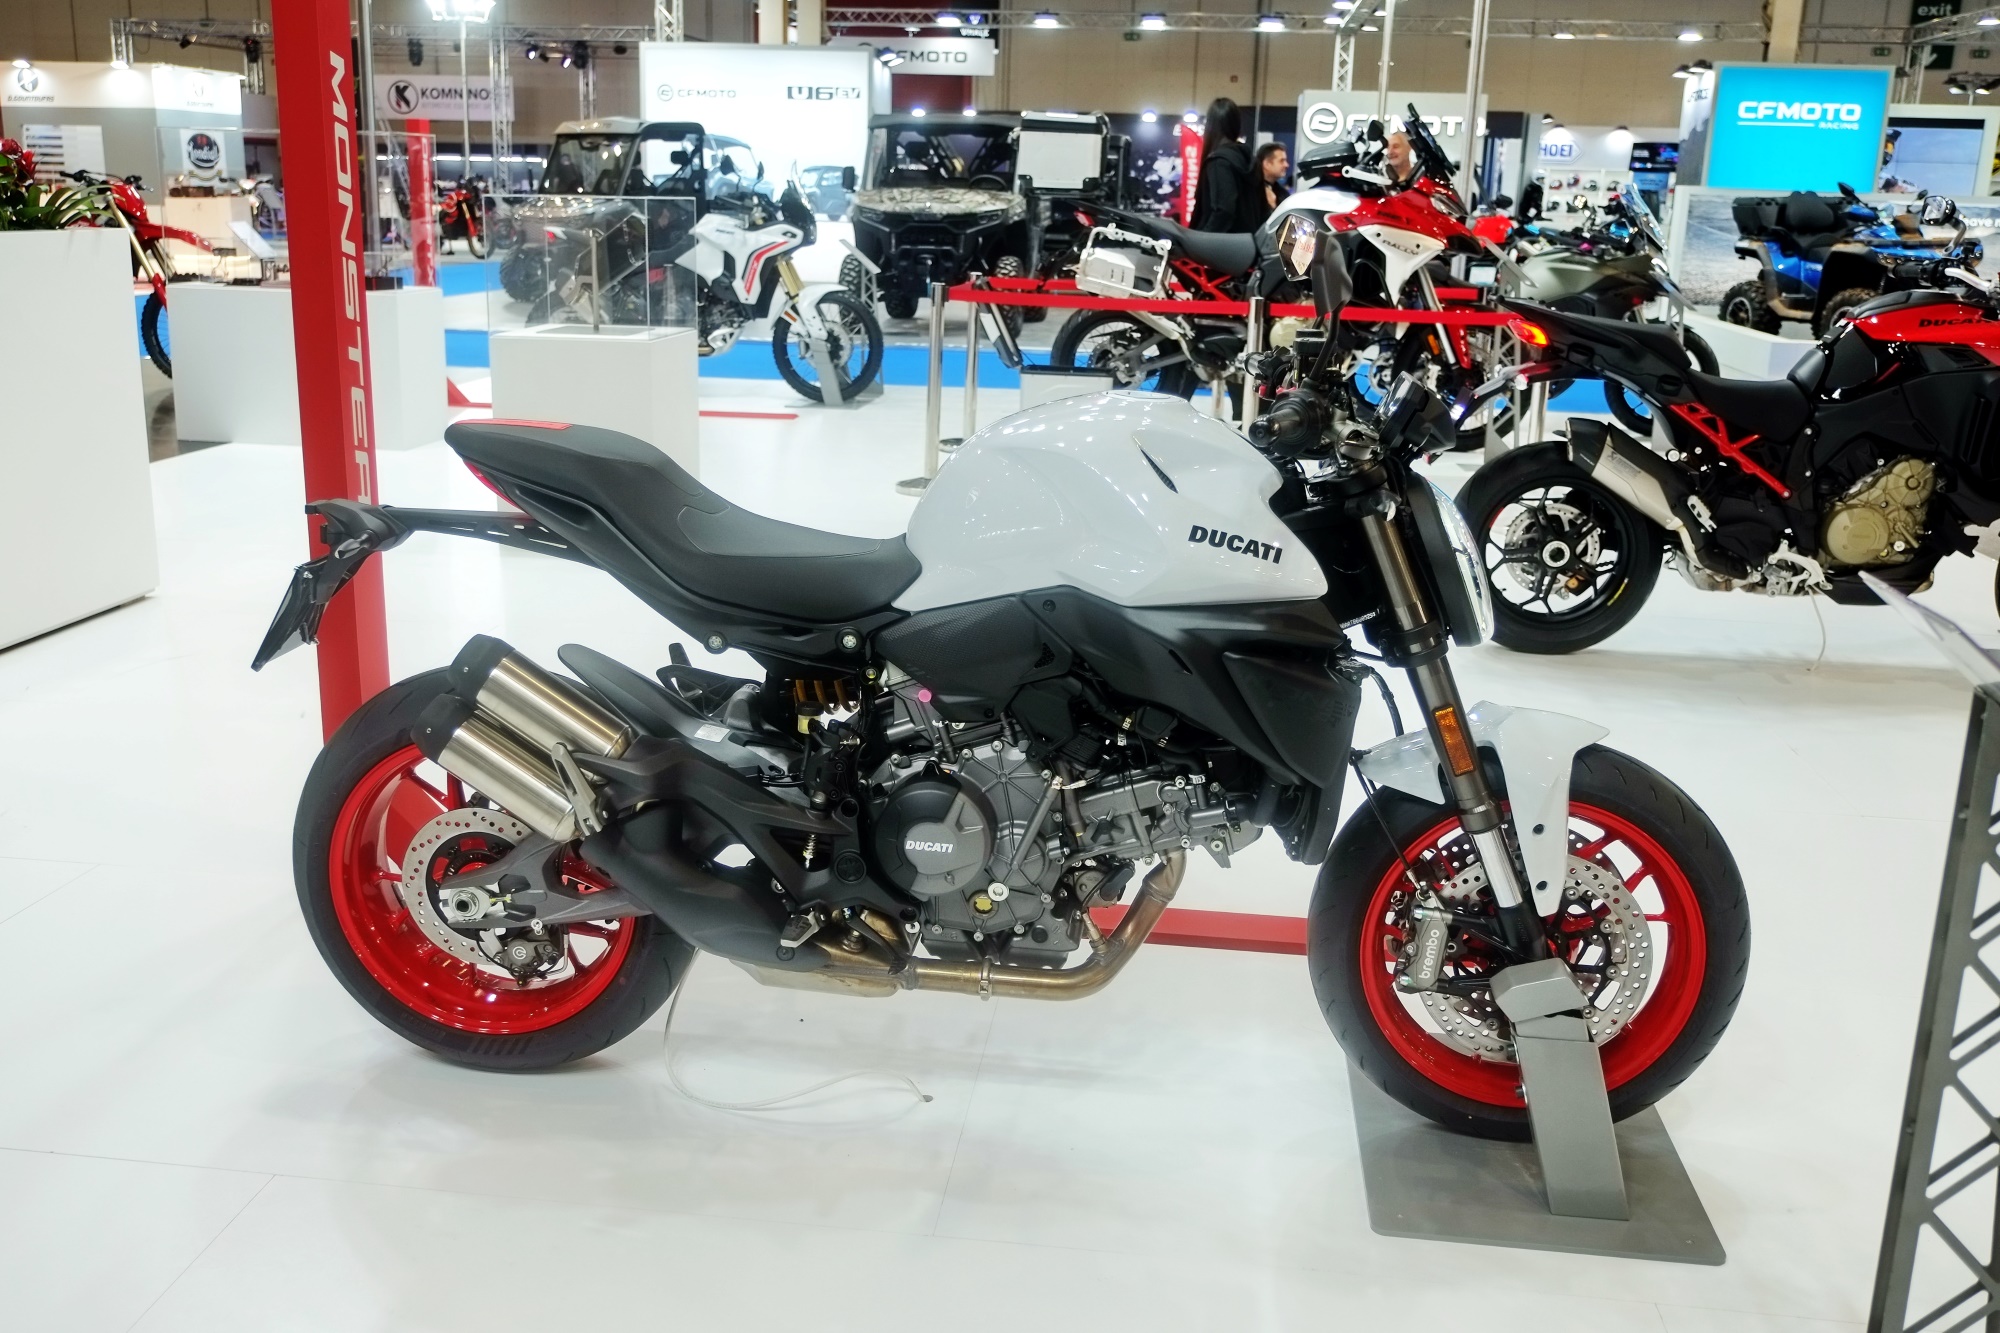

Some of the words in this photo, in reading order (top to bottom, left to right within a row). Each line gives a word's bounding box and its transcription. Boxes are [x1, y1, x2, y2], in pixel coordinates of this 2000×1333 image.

[1917, 4, 1952, 16] exit
[896, 50, 968, 64] FMOTO
[420, 87, 493, 100] KOMNNO
[677, 89, 737, 98] CFMOTO
[1737, 101, 1862, 122] CFMOTO
[1818, 122, 1859, 131] RACING
[1538, 143, 1573, 157] HOEI
[329, 50, 371, 505] MONSTER
[1188, 525, 1283, 564] DUCATI
[905, 840, 954, 853] DUCATI
[1418, 929, 1440, 979] brembo
